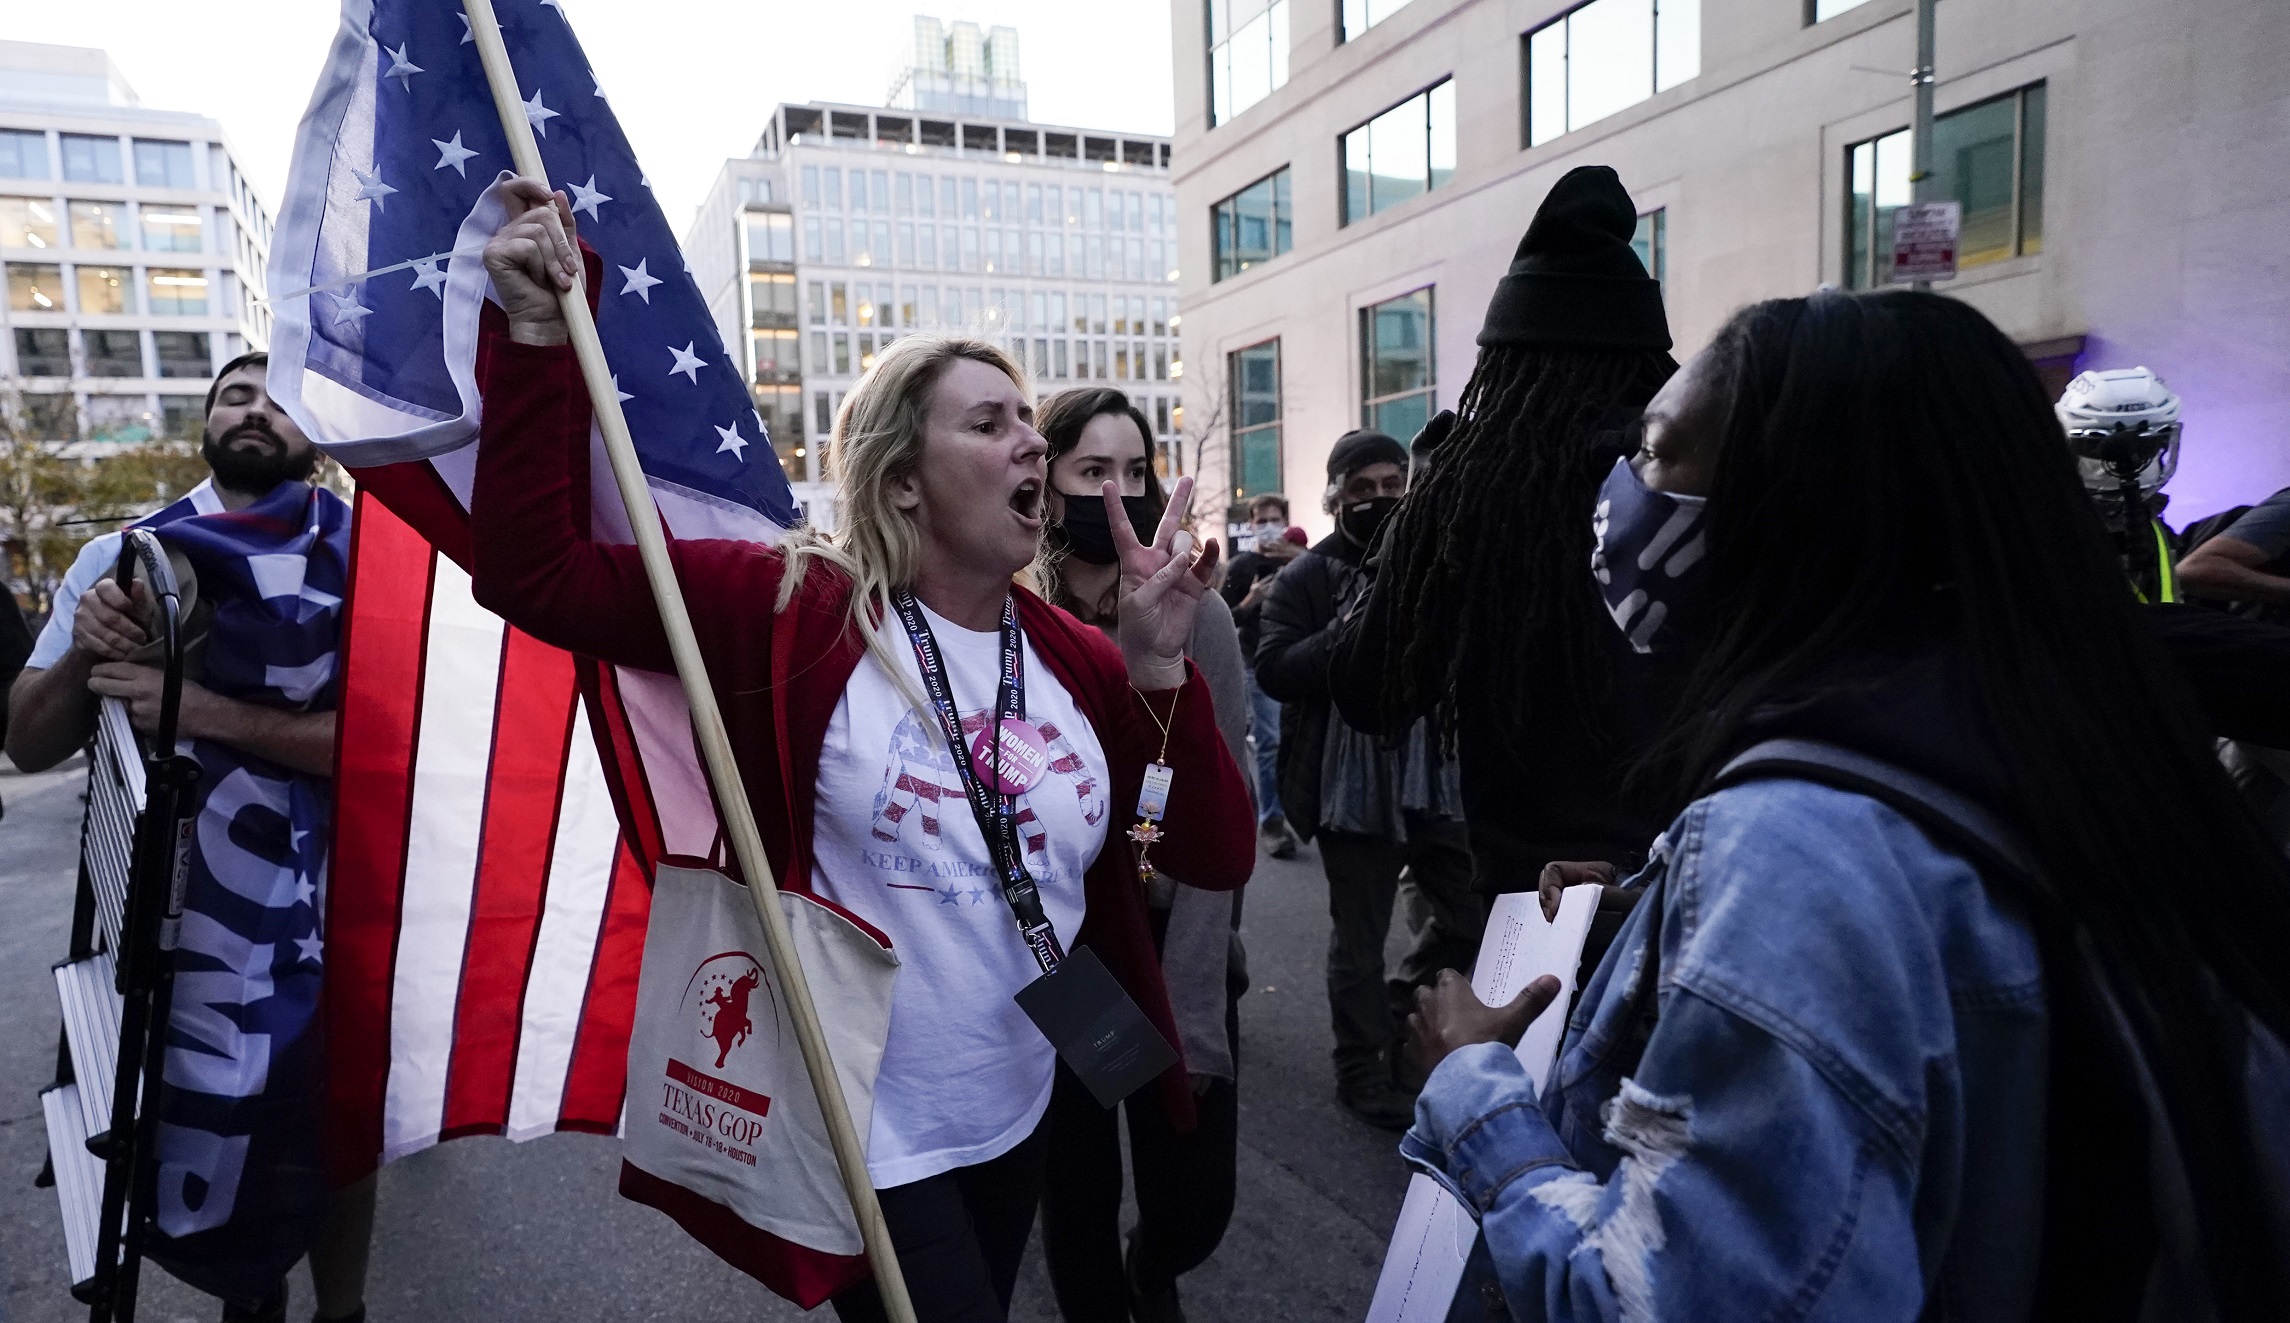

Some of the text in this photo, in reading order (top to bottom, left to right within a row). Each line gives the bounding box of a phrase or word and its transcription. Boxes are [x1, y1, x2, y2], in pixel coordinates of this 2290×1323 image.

[903, 610, 918, 631] 2020
[919, 629, 942, 697] Trump 2020
[1003, 648, 1015, 686] Trump
[1010, 689, 1018, 710] 2020
[954, 743, 967, 766] 2020
[999, 725, 1045, 768] WOMEN
[1003, 749, 1018, 764] FOR
[978, 744, 1028, 787] TRUMP
[863, 850, 923, 873] KEEP
[926, 861, 999, 879] AMERIC
[1093, 1030, 1115, 1048] TRUMP
[686, 1072, 741, 1103] VISION 2020
[663, 1083, 763, 1147] TEXAS GOP
[659, 1112, 689, 1137] CONVENTION
[692, 1129, 706, 1144] JULY
[727, 1145, 757, 1168] HOUSTON
